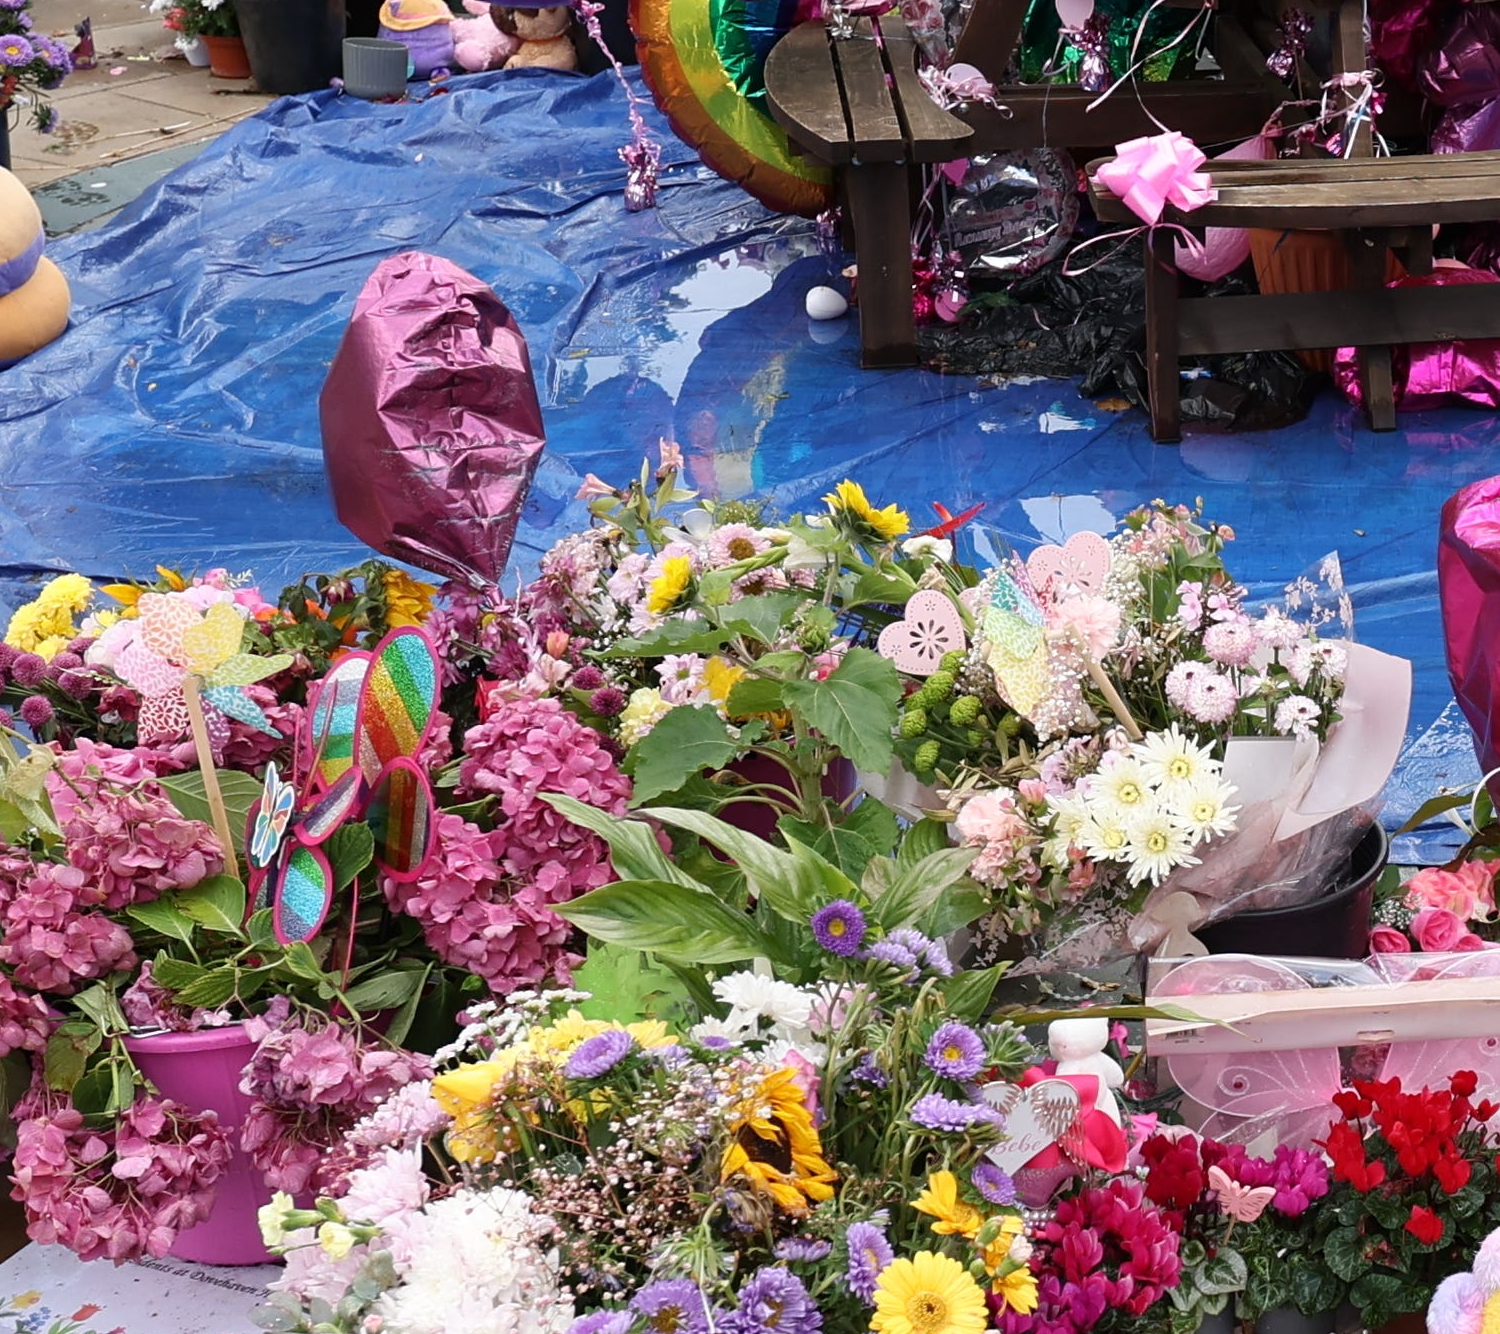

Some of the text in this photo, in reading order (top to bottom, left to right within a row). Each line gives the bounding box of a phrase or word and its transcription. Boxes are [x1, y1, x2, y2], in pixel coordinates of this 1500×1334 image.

[991, 1132, 1043, 1155] Bebe
[137, 1256, 173, 1274] dents
[172, 1263, 190, 1277] at
[189, 1269, 261, 1296] Dovehaven
